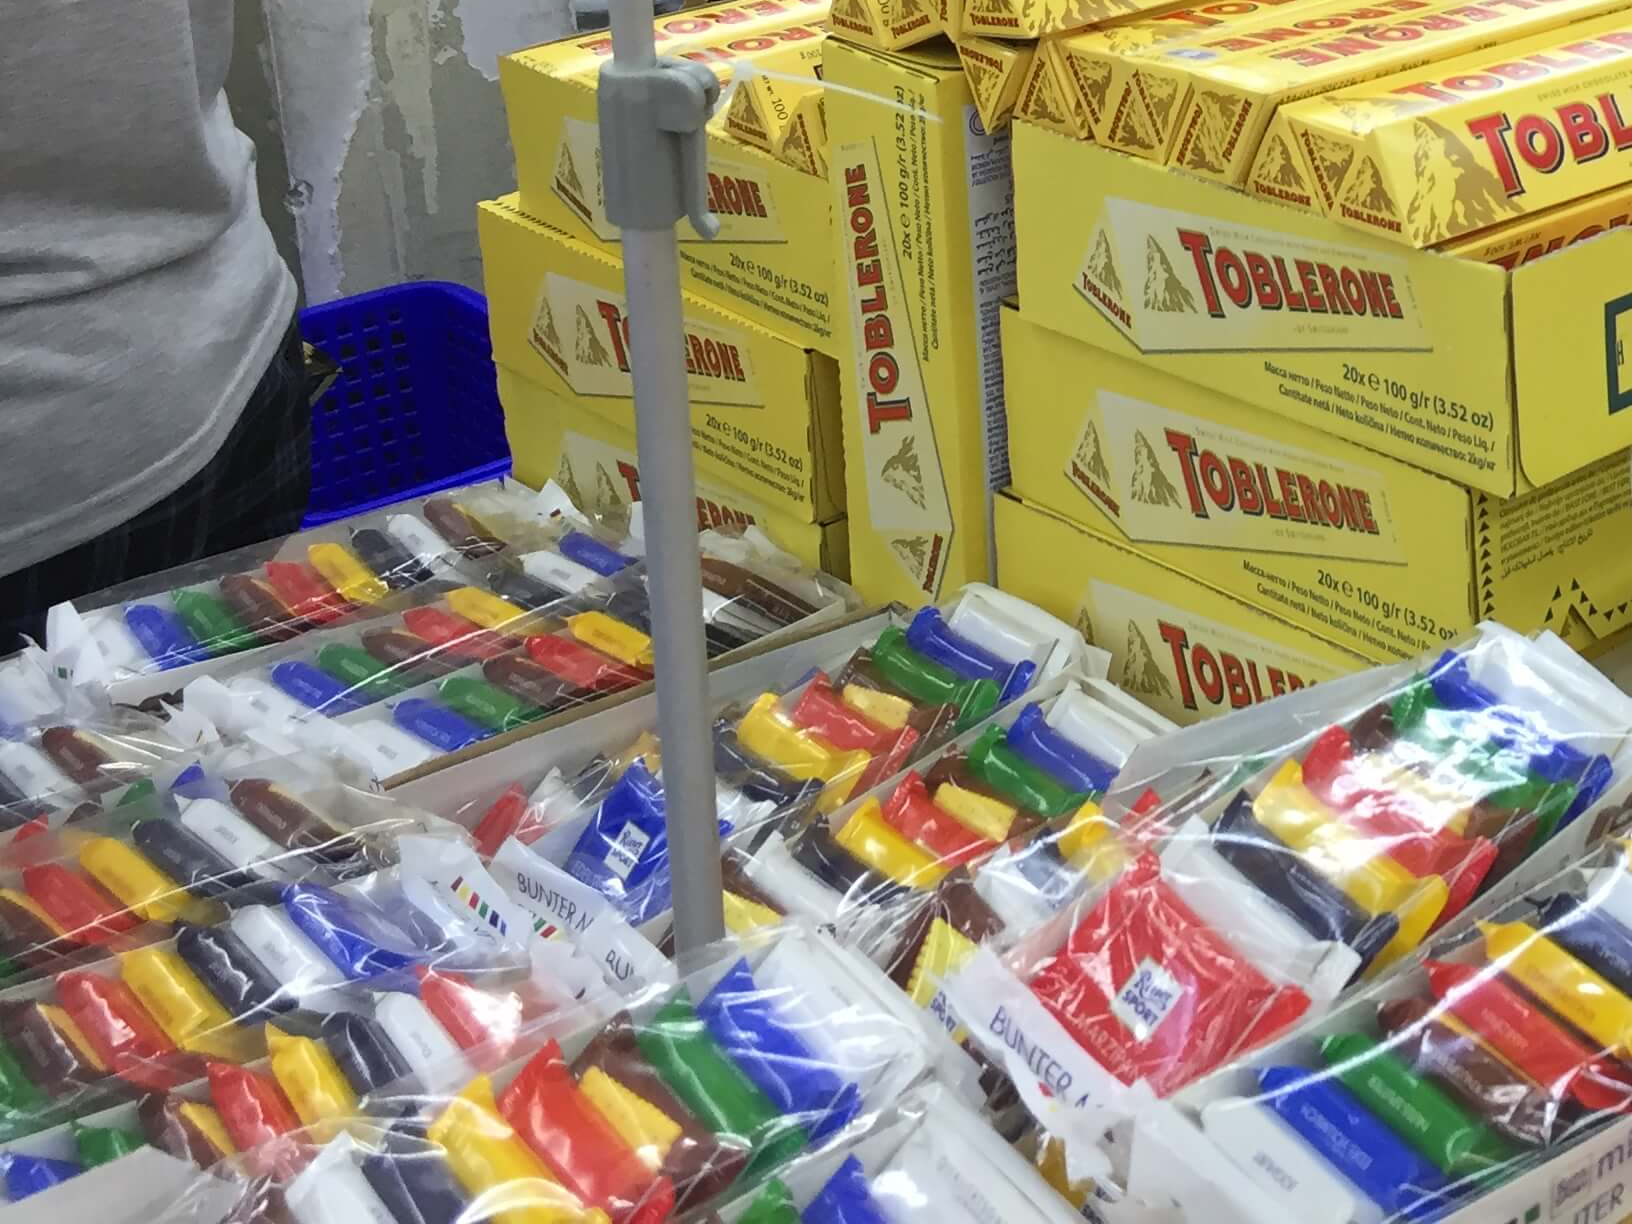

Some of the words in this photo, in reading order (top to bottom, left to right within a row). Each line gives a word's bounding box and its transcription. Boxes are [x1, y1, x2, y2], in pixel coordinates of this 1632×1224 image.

[833, 12, 875, 37] TOBLERONE
[969, 12, 1020, 28] TOBLERONE
[1221, 97, 1253, 164] TOBLERONE
[899, 181, 910, 209] 100
[1252, 179, 1313, 209] TOBLERONE
[1339, 201, 1403, 234] TOBLERONE
[902, 229, 914, 261] 20x
[756, 264, 774, 284] 100
[843, 162, 914, 436] TOBLERONE
[1176, 227, 1405, 320] TOBLERONE
[1081, 271, 1134, 331] TOBLERONE
[1341, 363, 1366, 387] 20x
[1383, 378, 1408, 402] 100
[1433, 394, 1468, 423] (3.52
[1470, 410, 1496, 434] oz)
[732, 426, 749, 446] 100
[1070, 461, 1122, 519] TOBLERONE
[1163, 426, 1381, 536] TOBLERONE
[1316, 568, 1341, 594] 20x
[1355, 586, 1380, 611] 100
[1404, 606, 1437, 637] (3.52
[515, 872, 578, 925] BUNTER
[1120, 987, 1161, 1029] SPORT
[988, 1005, 1075, 1101] BUNTER
